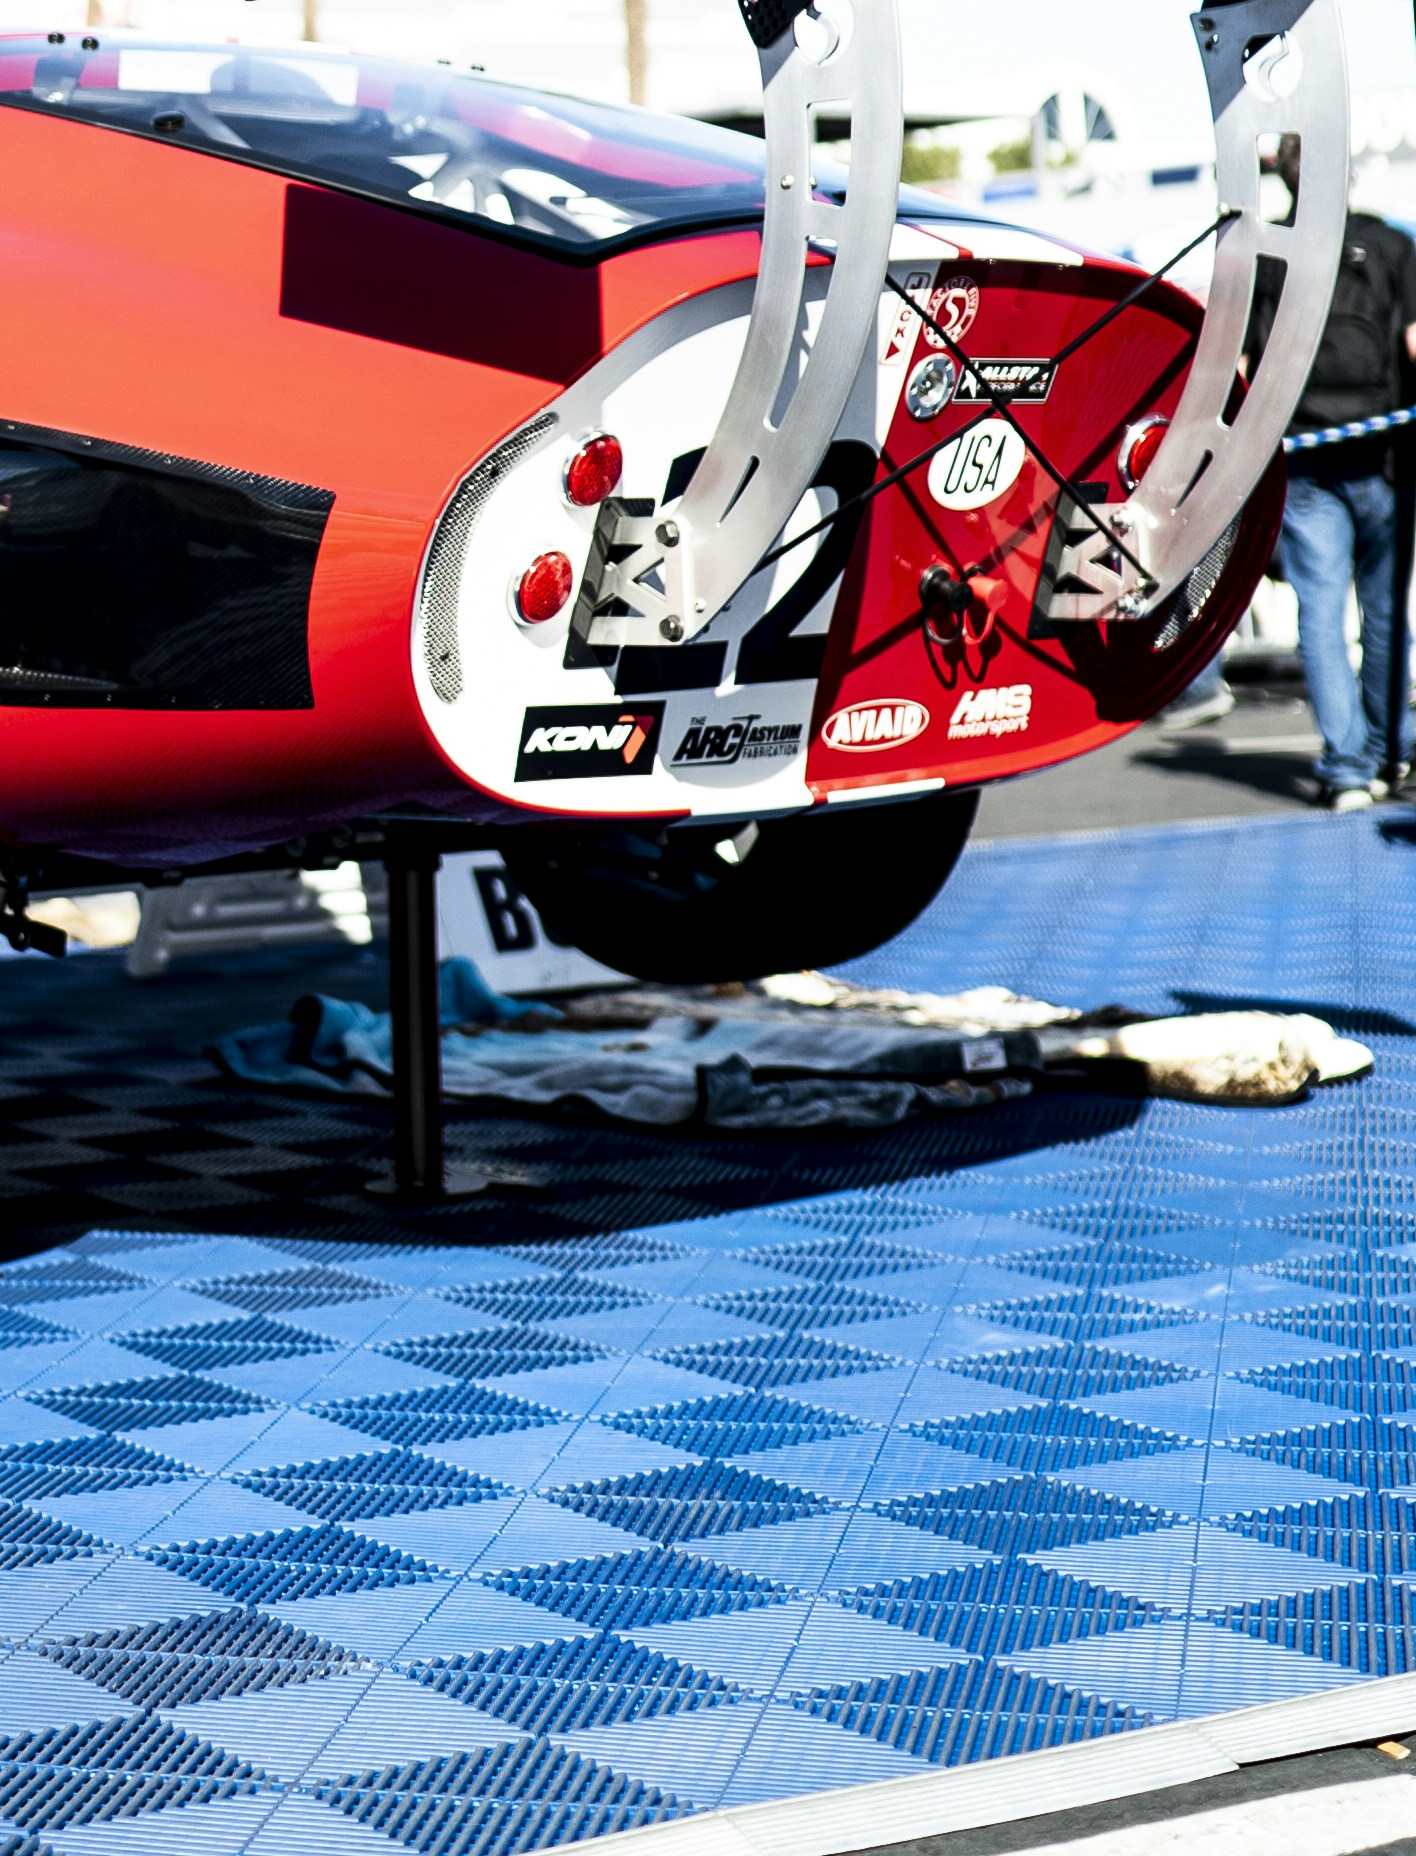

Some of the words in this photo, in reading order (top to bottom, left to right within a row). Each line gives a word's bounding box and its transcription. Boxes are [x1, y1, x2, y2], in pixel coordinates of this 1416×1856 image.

[895, 276, 925, 338] JCK
[944, 435, 1010, 494] USA
[689, 716, 708, 726] THE
[949, 684, 1033, 725] HMS
[524, 722, 634, 754] KONI
[747, 724, 803, 743] ASYLUM
[830, 705, 923, 744] AVIAID
[947, 715, 1030, 741] motorsport
[672, 723, 745, 762] ARC
[742, 744, 800, 760] FABRICATION
